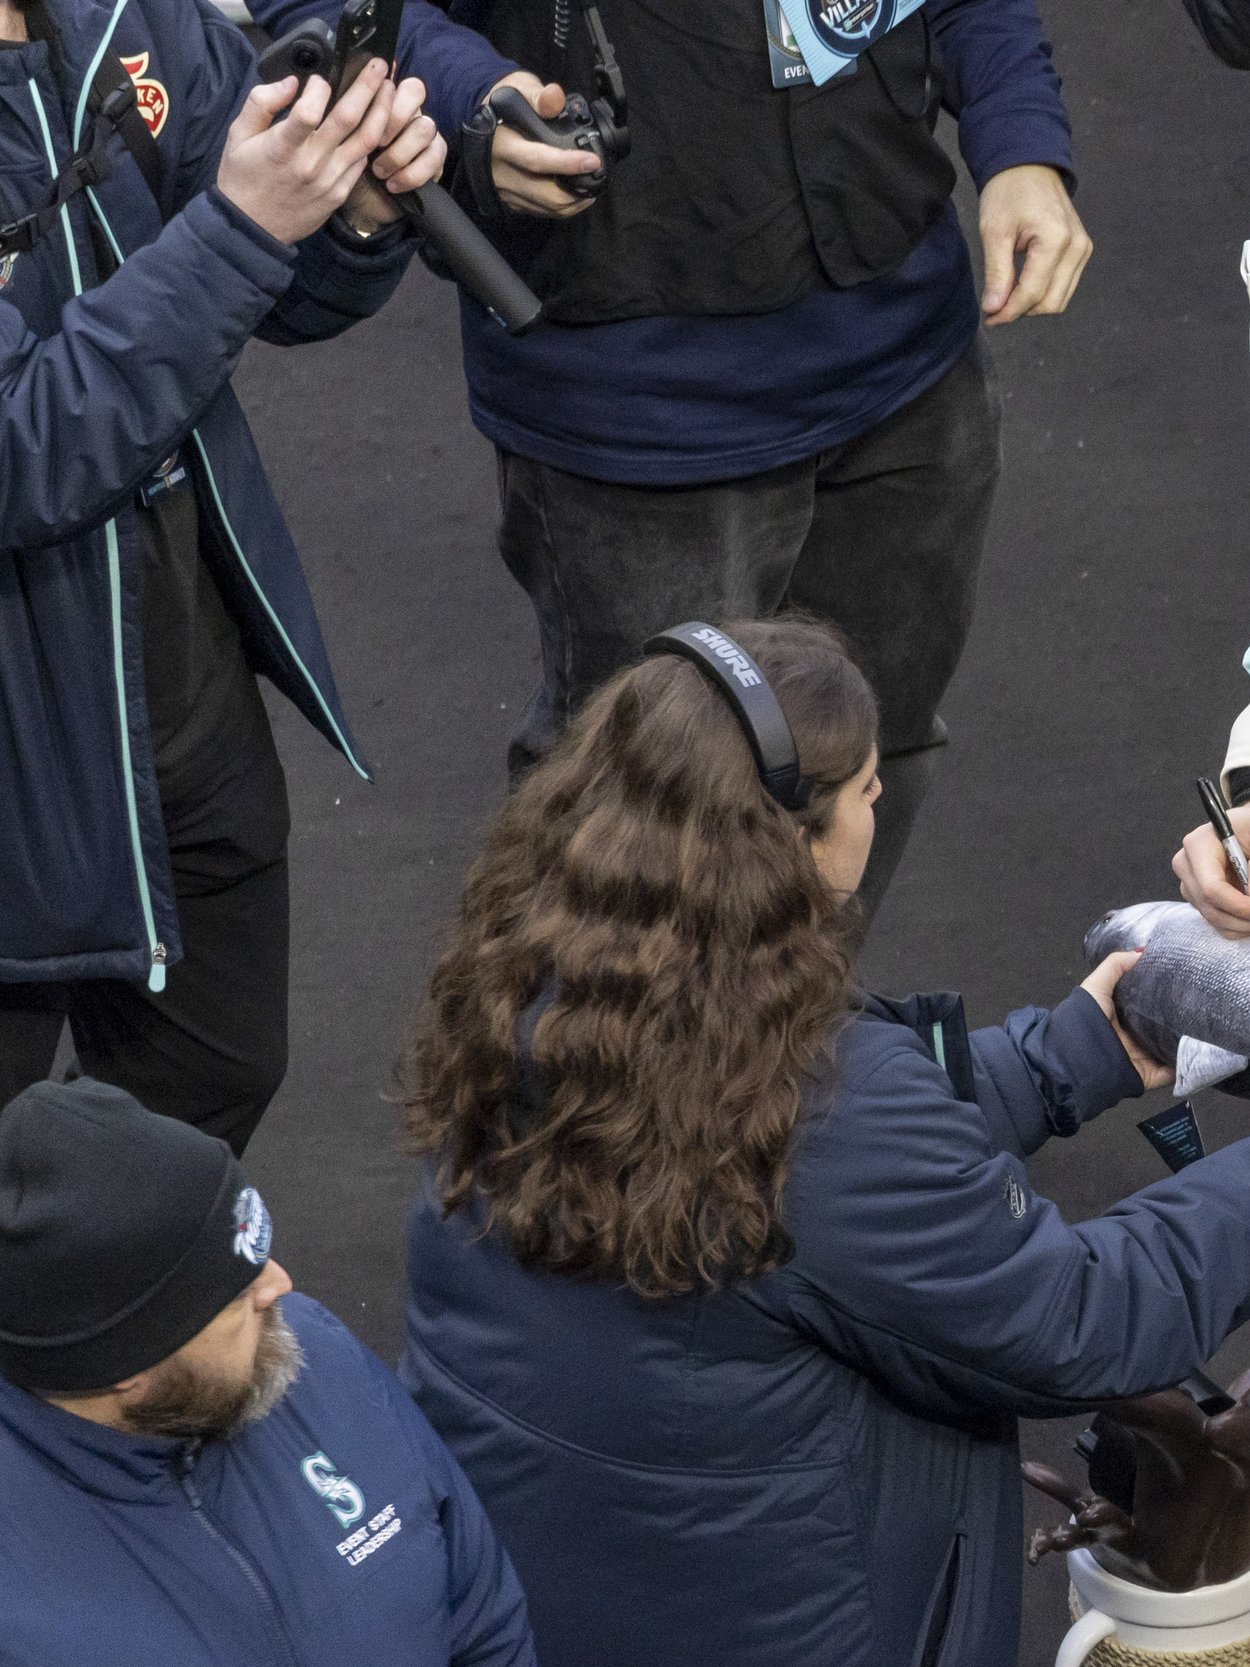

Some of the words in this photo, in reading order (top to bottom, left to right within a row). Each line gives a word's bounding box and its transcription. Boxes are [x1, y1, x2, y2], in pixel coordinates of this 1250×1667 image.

[819, 0, 866, 28] VILL
[691, 628, 762, 688] SHURE
[336, 1526, 370, 1556] EVENT
[368, 1504, 396, 1531] STAFF
[346, 1518, 402, 1566] LEADERSHIP
